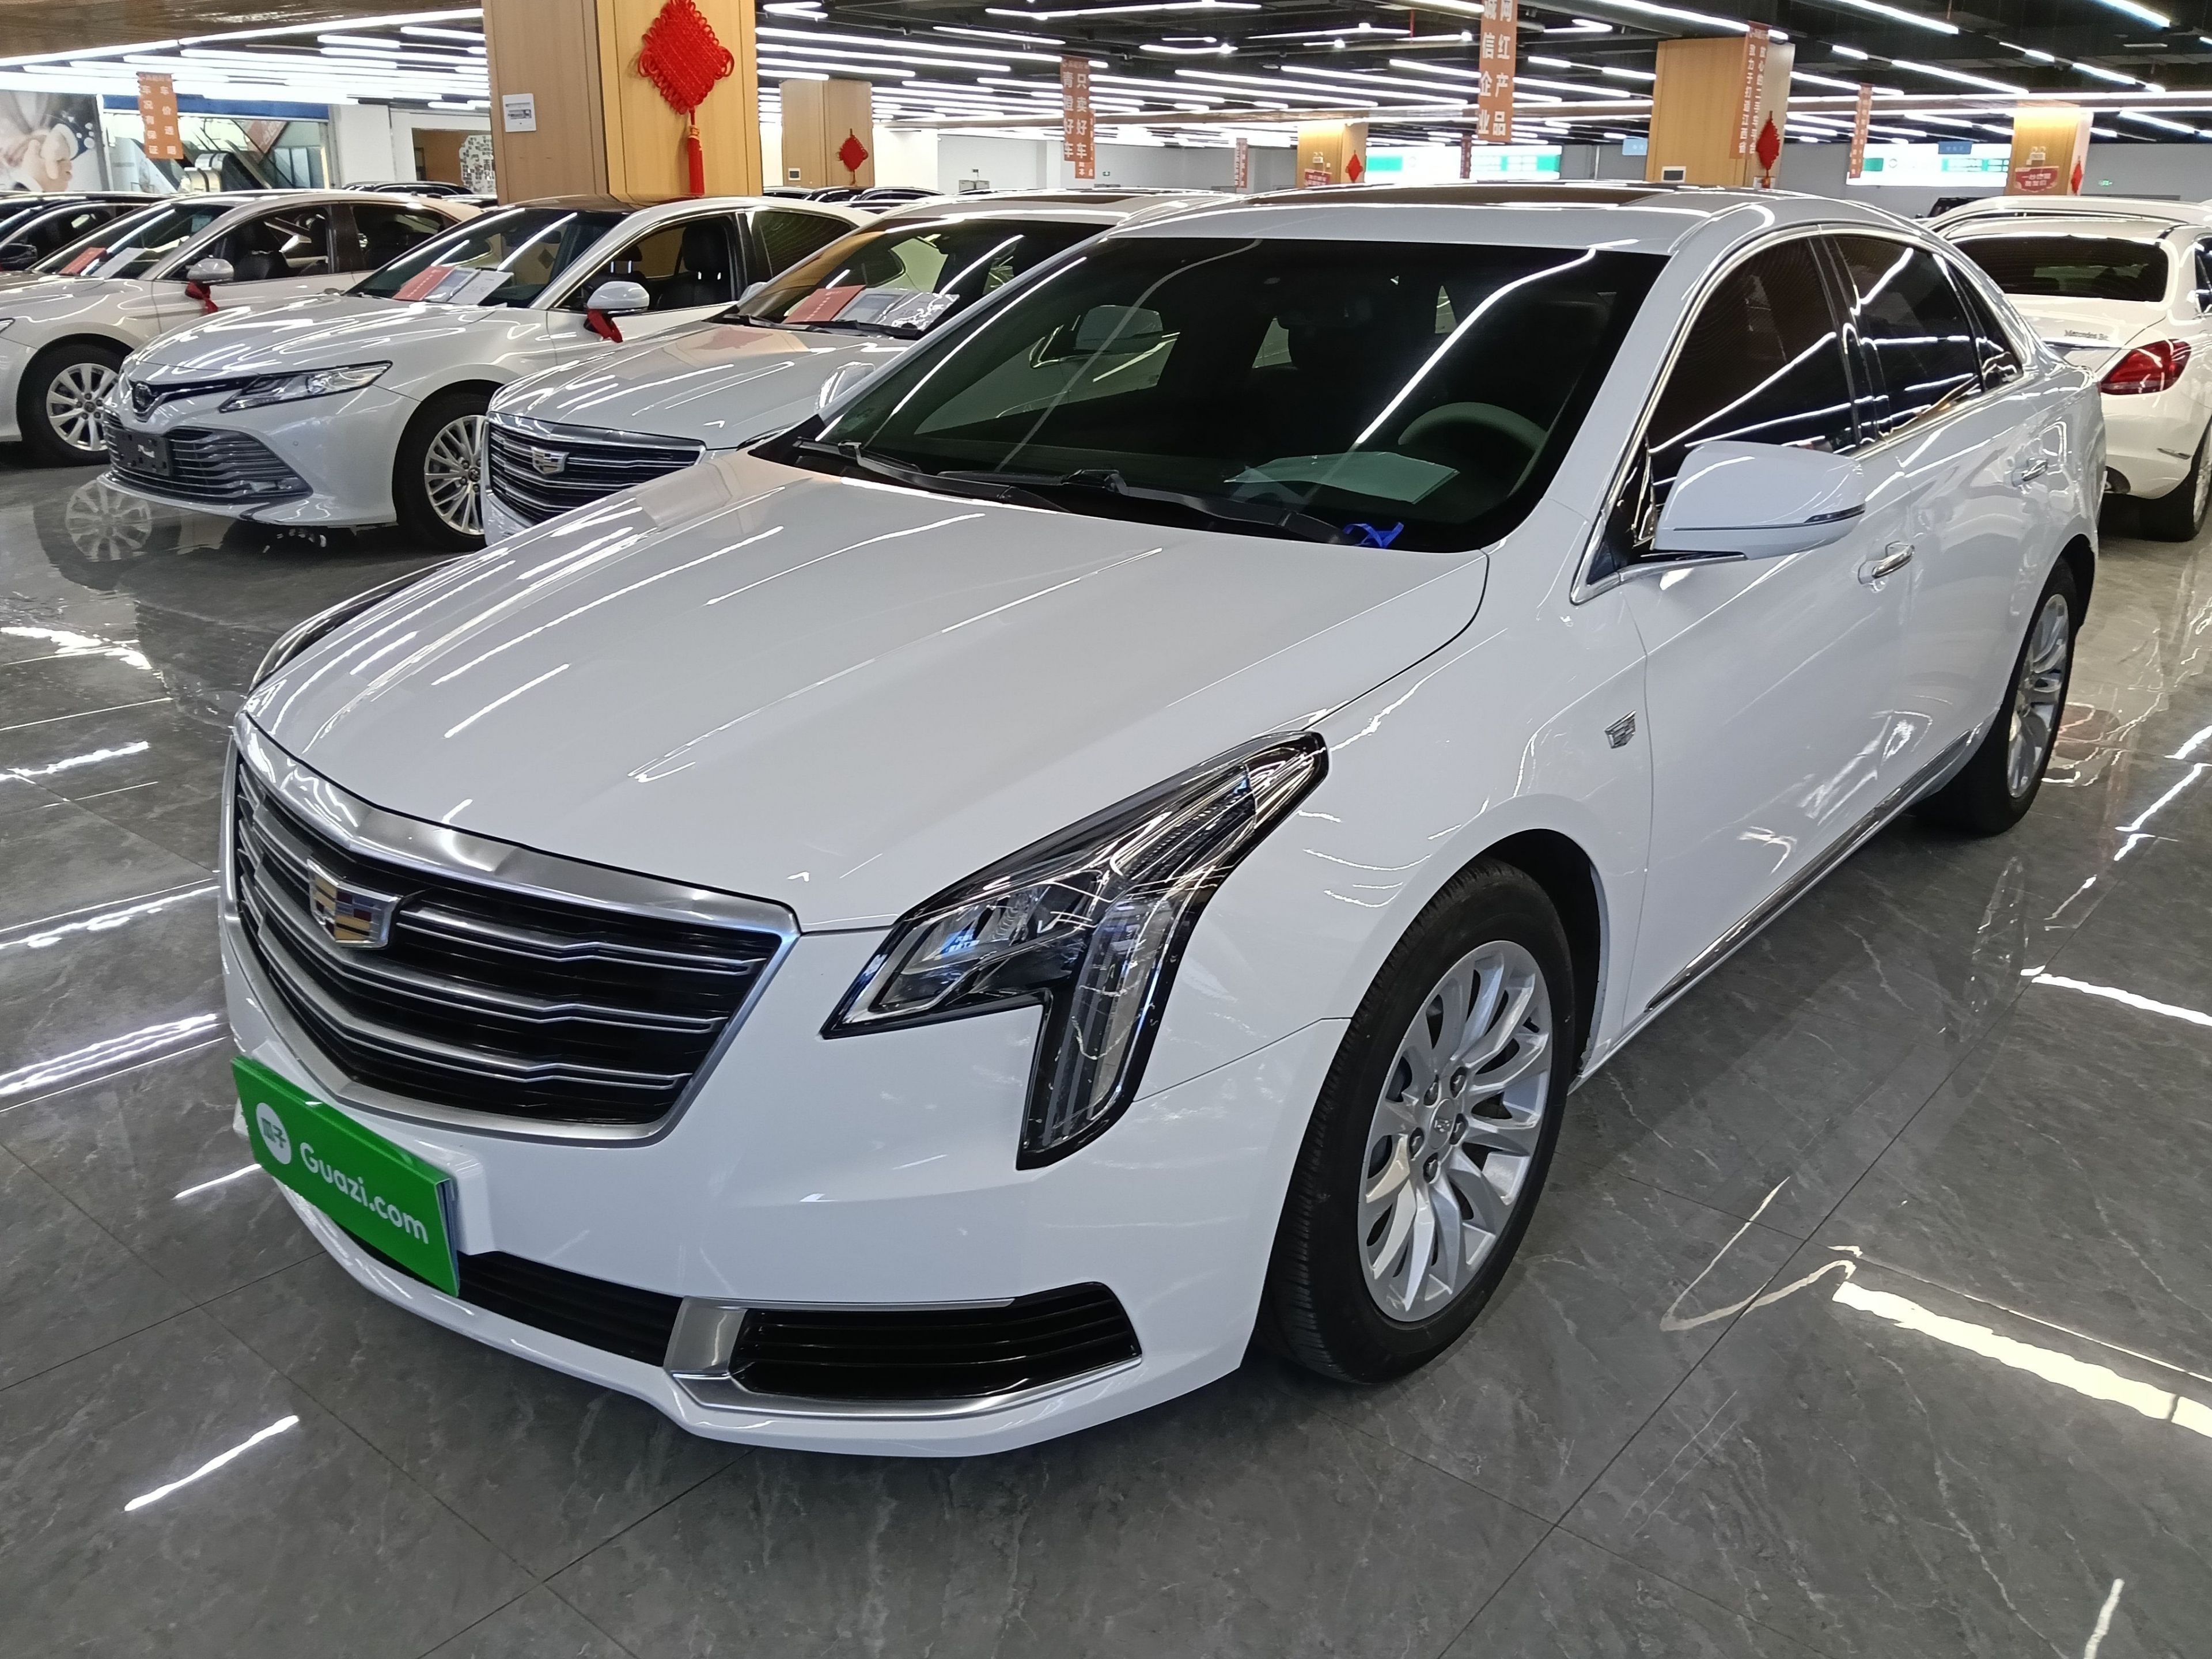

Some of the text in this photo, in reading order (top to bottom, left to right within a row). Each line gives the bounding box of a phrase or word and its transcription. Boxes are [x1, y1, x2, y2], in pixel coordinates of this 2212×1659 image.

[1493, 0, 1513, 136] 网红产品
[141, 85, 159, 155] 车况有保证
[160, 86, 176, 155] 车价透明
[1063, 71, 1074, 158] 青橙好车
[1076, 73, 1087, 158] 只卖好车
[300, 1142, 429, 1244] Guazi.com
